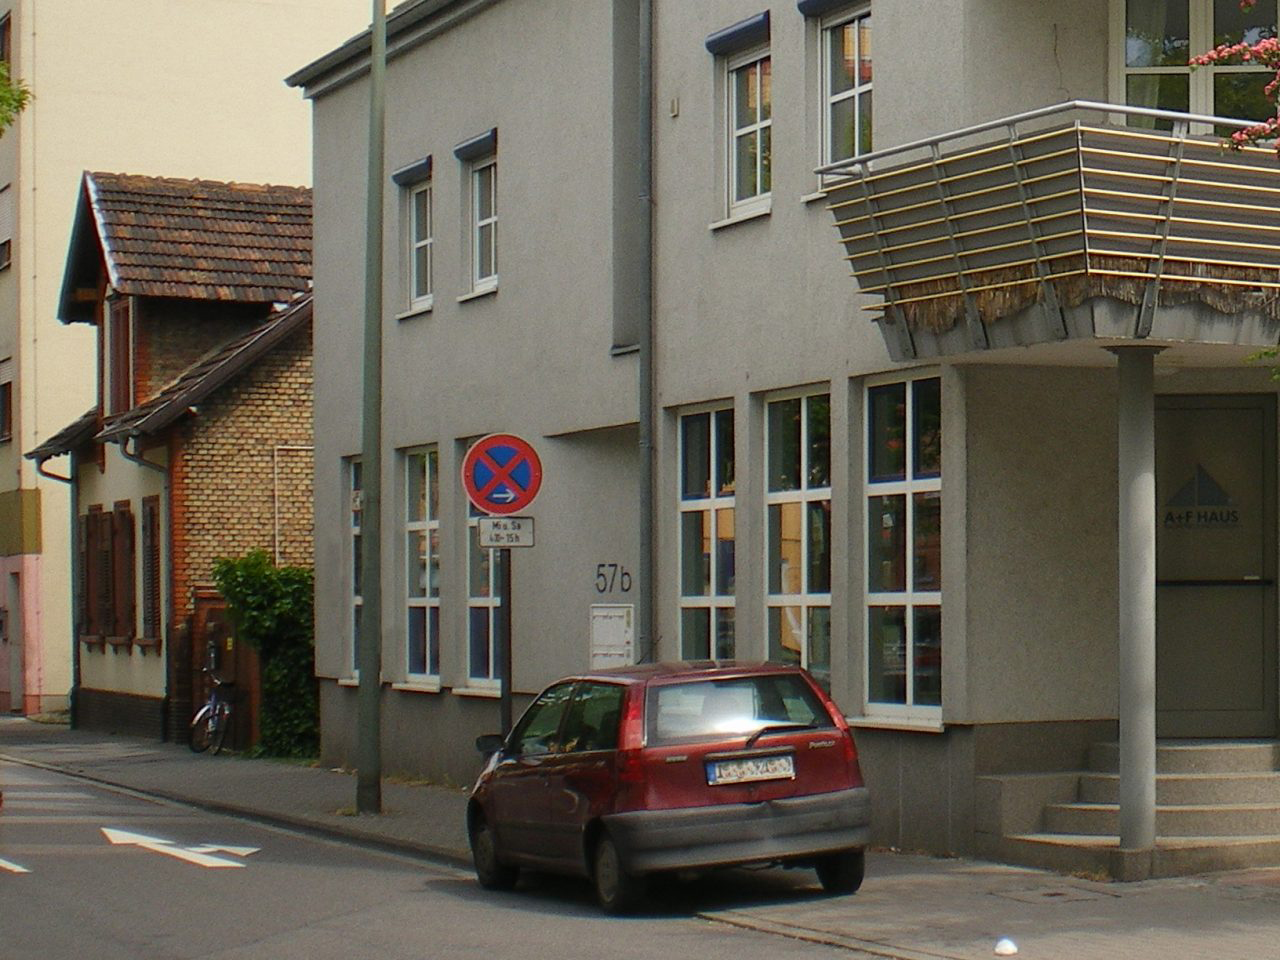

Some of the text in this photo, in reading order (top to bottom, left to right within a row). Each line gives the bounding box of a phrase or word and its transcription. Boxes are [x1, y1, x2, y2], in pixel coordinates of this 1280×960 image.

[1164, 510, 1239, 523] A+F HAUS
[595, 563, 632, 593] 57b
